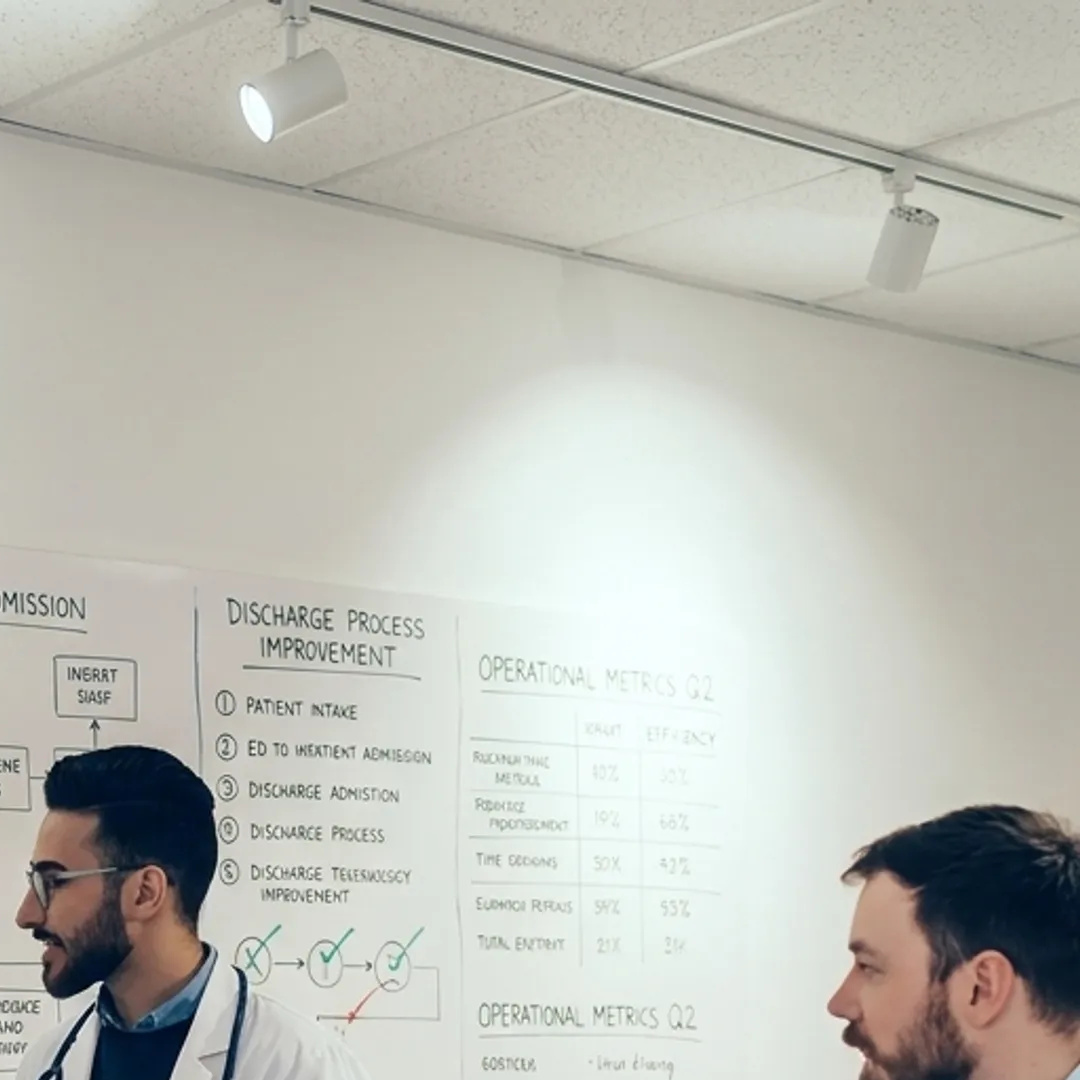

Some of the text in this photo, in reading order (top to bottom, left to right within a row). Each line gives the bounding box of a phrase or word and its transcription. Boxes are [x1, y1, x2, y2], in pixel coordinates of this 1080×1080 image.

[226, 597, 426, 640] DISCHARGE PROCESS
[260, 637, 396, 668] IMPROVEMENT
[478, 653, 596, 691] OPERATIONAL
[246, 695, 304, 717] PATIENT
[248, 739, 268, 757] ED
[272, 742, 290, 758] TO
[478, 1002, 585, 1028] OPERATIONAL
[592, 1004, 660, 1030] METRICS
